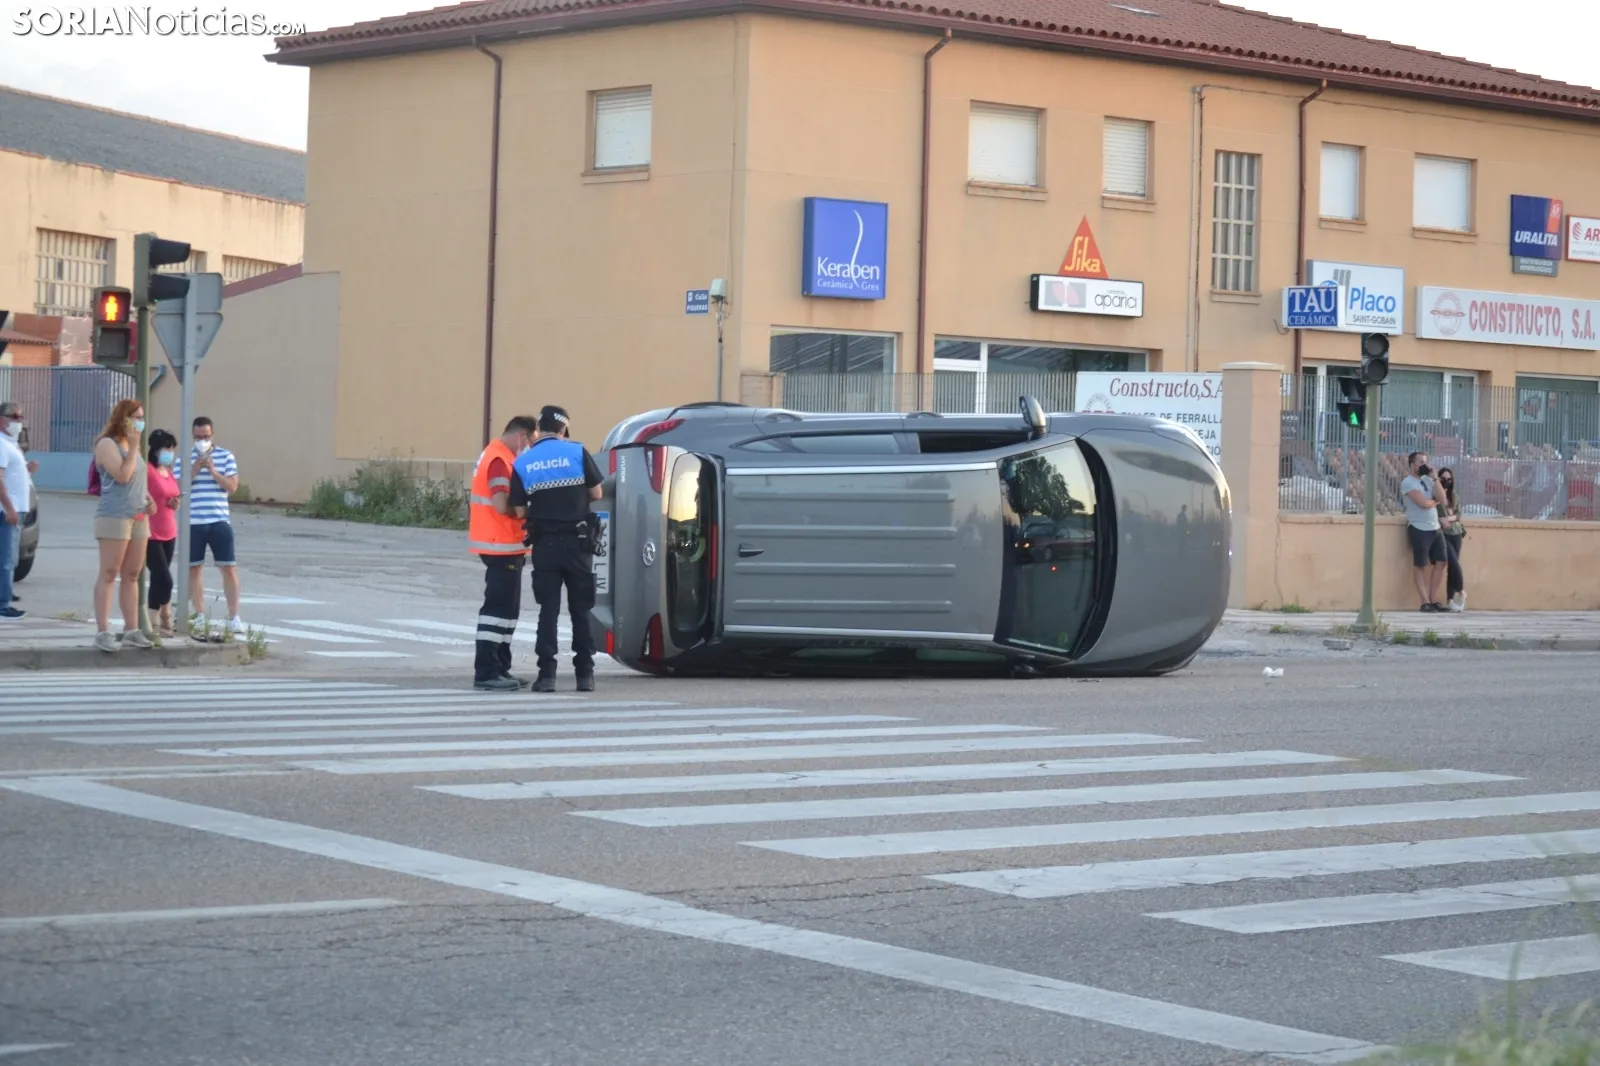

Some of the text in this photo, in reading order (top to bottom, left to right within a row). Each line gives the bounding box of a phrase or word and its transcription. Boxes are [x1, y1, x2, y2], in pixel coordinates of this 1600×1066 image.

[1514, 230, 1558, 247] URALITA
[1064, 236, 1101, 273] Sika
[816, 256, 880, 280] Keraben
[1289, 288, 1337, 313] TAU
[1349, 287, 1396, 313] Placo
[1288, 313, 1337, 325] CERÁMICA
[1353, 314, 1397, 326] SAINT-GOBAIN
[1468, 300, 1565, 345] CONSTRUCTO,
[1572, 308, 1596, 340] S.A.
[1176, 413, 1223, 424] FERRALL
